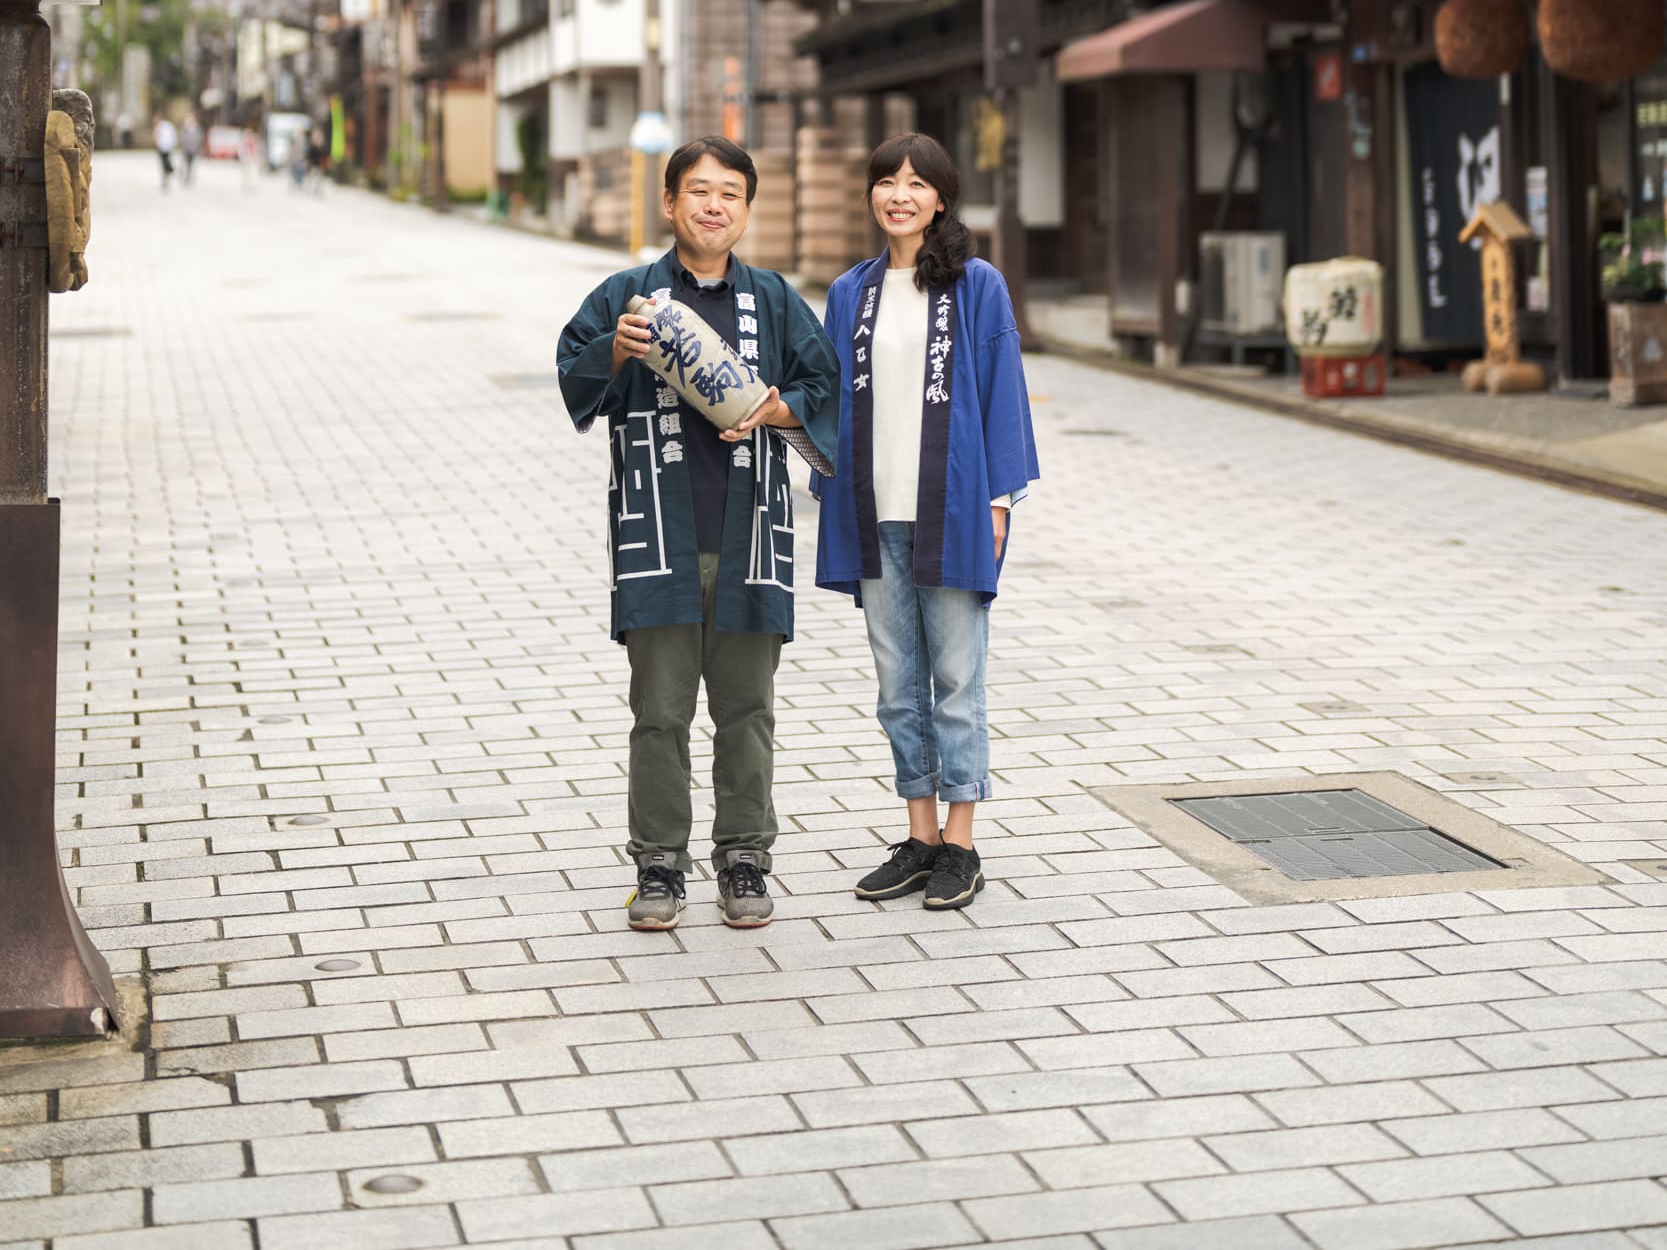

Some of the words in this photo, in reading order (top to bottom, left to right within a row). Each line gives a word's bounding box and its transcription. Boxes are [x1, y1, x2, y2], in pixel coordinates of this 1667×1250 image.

[936, 293, 952, 331] 大吟醸
[659, 326, 745, 407] 若駒
[853, 324, 872, 392] 八乙女
